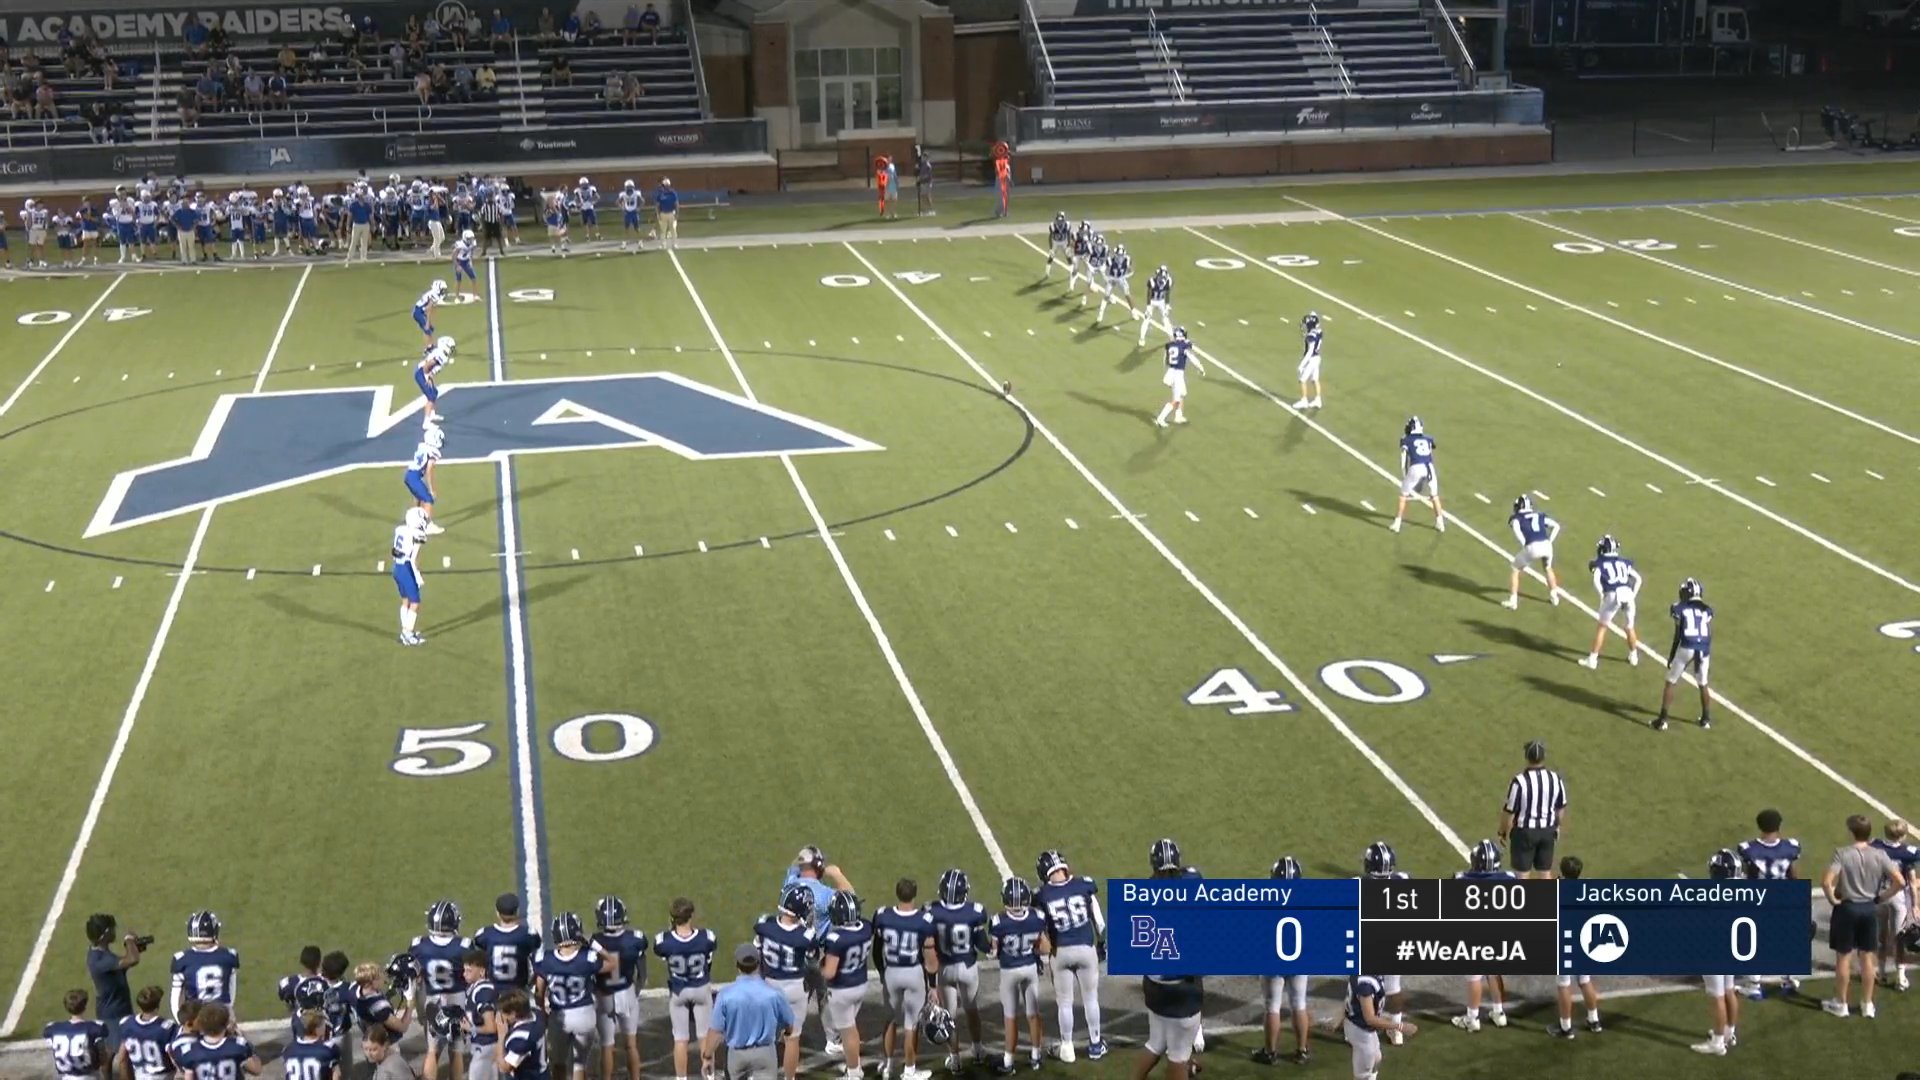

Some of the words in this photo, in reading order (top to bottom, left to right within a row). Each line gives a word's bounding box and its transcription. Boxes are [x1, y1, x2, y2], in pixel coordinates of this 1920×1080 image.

[17, 12, 189, 42] ACADEMY
[1057, 118, 1092, 128] VIKING
[537, 139, 577, 149] Trustmark
[658, 134, 699, 145] WATKINS
[1167, 346, 1180, 365] 2
[1524, 513, 1541, 532] 7
[1602, 560, 1629, 584] 10
[1682, 608, 1709, 637] 17
[763, 937, 800, 972] 51
[882, 928, 919, 964] 24
[492, 945, 517, 981] 5
[195, 964, 223, 1000] 6
